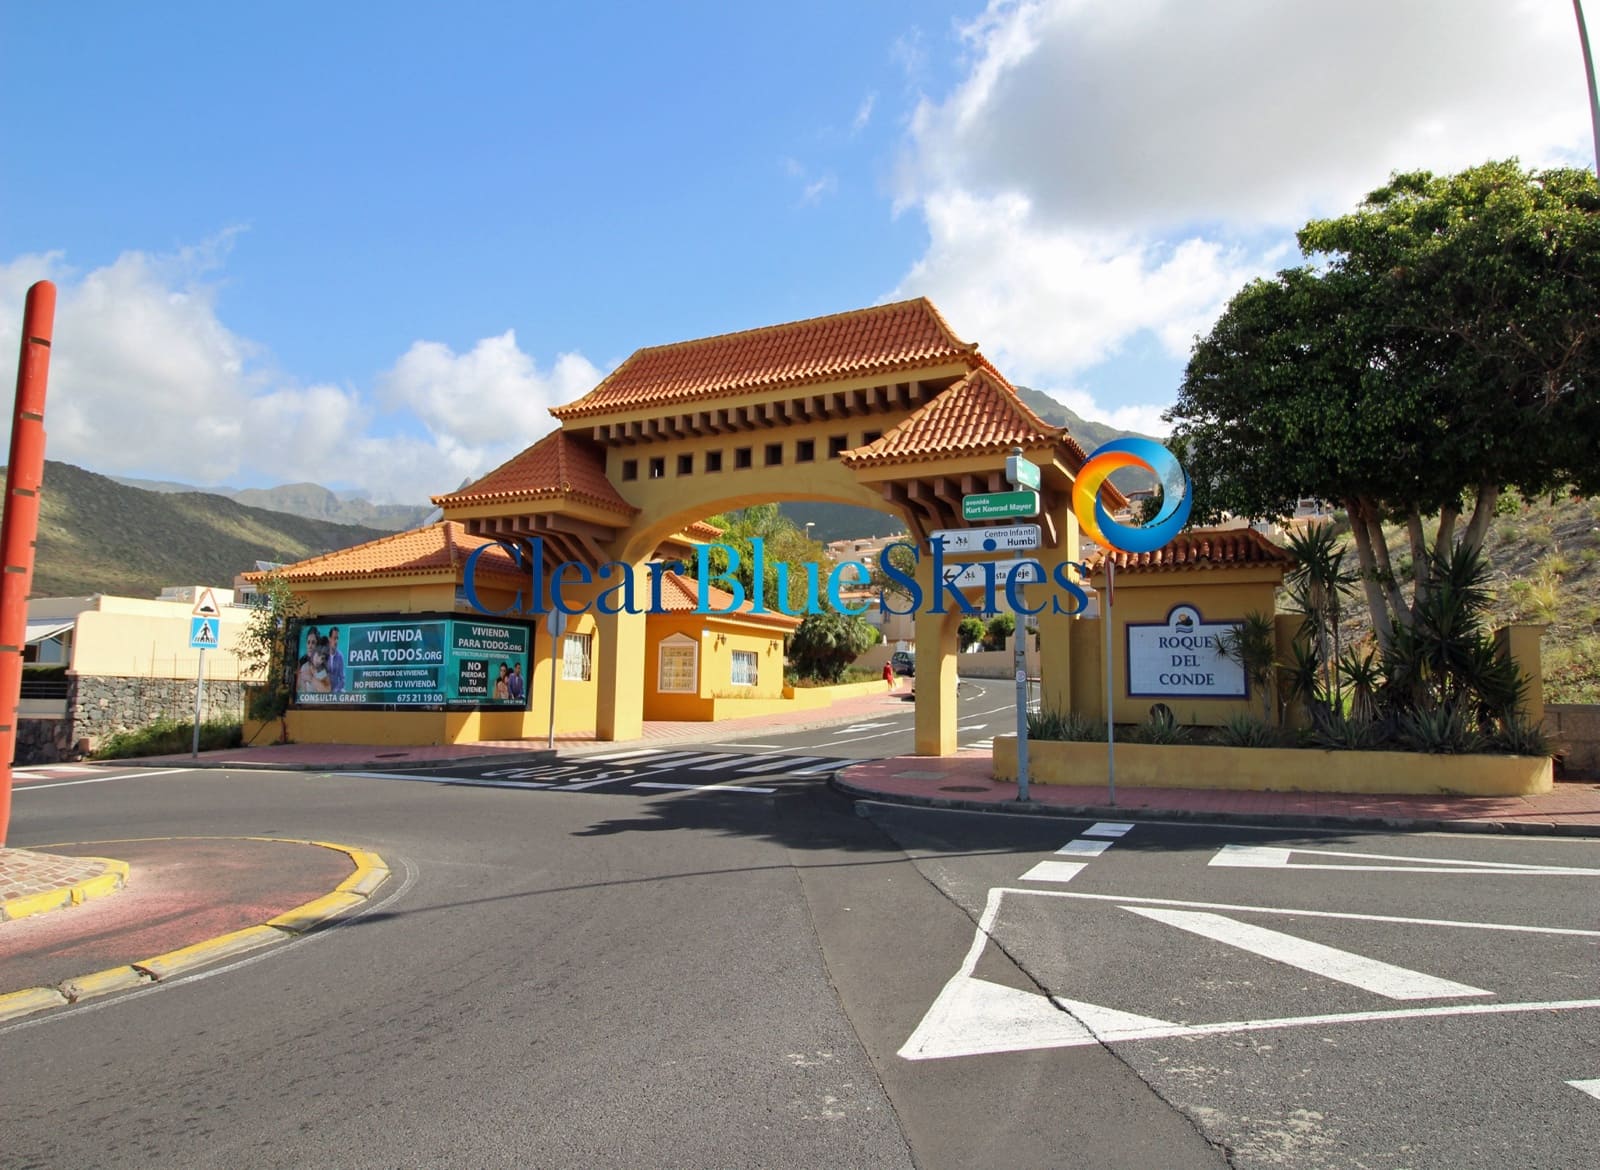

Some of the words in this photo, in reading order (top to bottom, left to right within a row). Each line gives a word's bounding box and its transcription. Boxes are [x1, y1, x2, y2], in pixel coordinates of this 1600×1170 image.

[966, 506, 981, 514] Kurt
[982, 504, 1008, 513] Konrad
[1010, 503, 1032, 511] Mayer
[984, 530, 1009, 538] Centro
[1009, 527, 1035, 537] Infantil
[1007, 537, 1036, 546] Humbi
[367, 629, 423, 643] VIVIENDA
[472, 626, 510, 638] VIVIENDA
[458, 638, 480, 648] PARA
[482, 640, 522, 651] TODOS.ORG
[1159, 636, 1214, 650] ROQUE
[350, 649, 379, 662] PARA
[381, 648, 442, 661] TODOS.ORG
[1172, 654, 1200, 667] DEL
[467, 662, 481, 671] NO
[354, 681, 364, 689] NO
[365, 680, 392, 689] PIERDAS
[395, 680, 403, 688] TU
[404, 679, 436, 688] VIVIENDA
[1159, 673, 1215, 685] CONDE
[299, 694, 337, 702] CONSULTA
[339, 694, 366, 702] GRATIS
[397, 693, 411, 702] 675
[412, 693, 421, 702] 21
[423, 693, 432, 702] 19
[433, 693, 443, 702] 00
